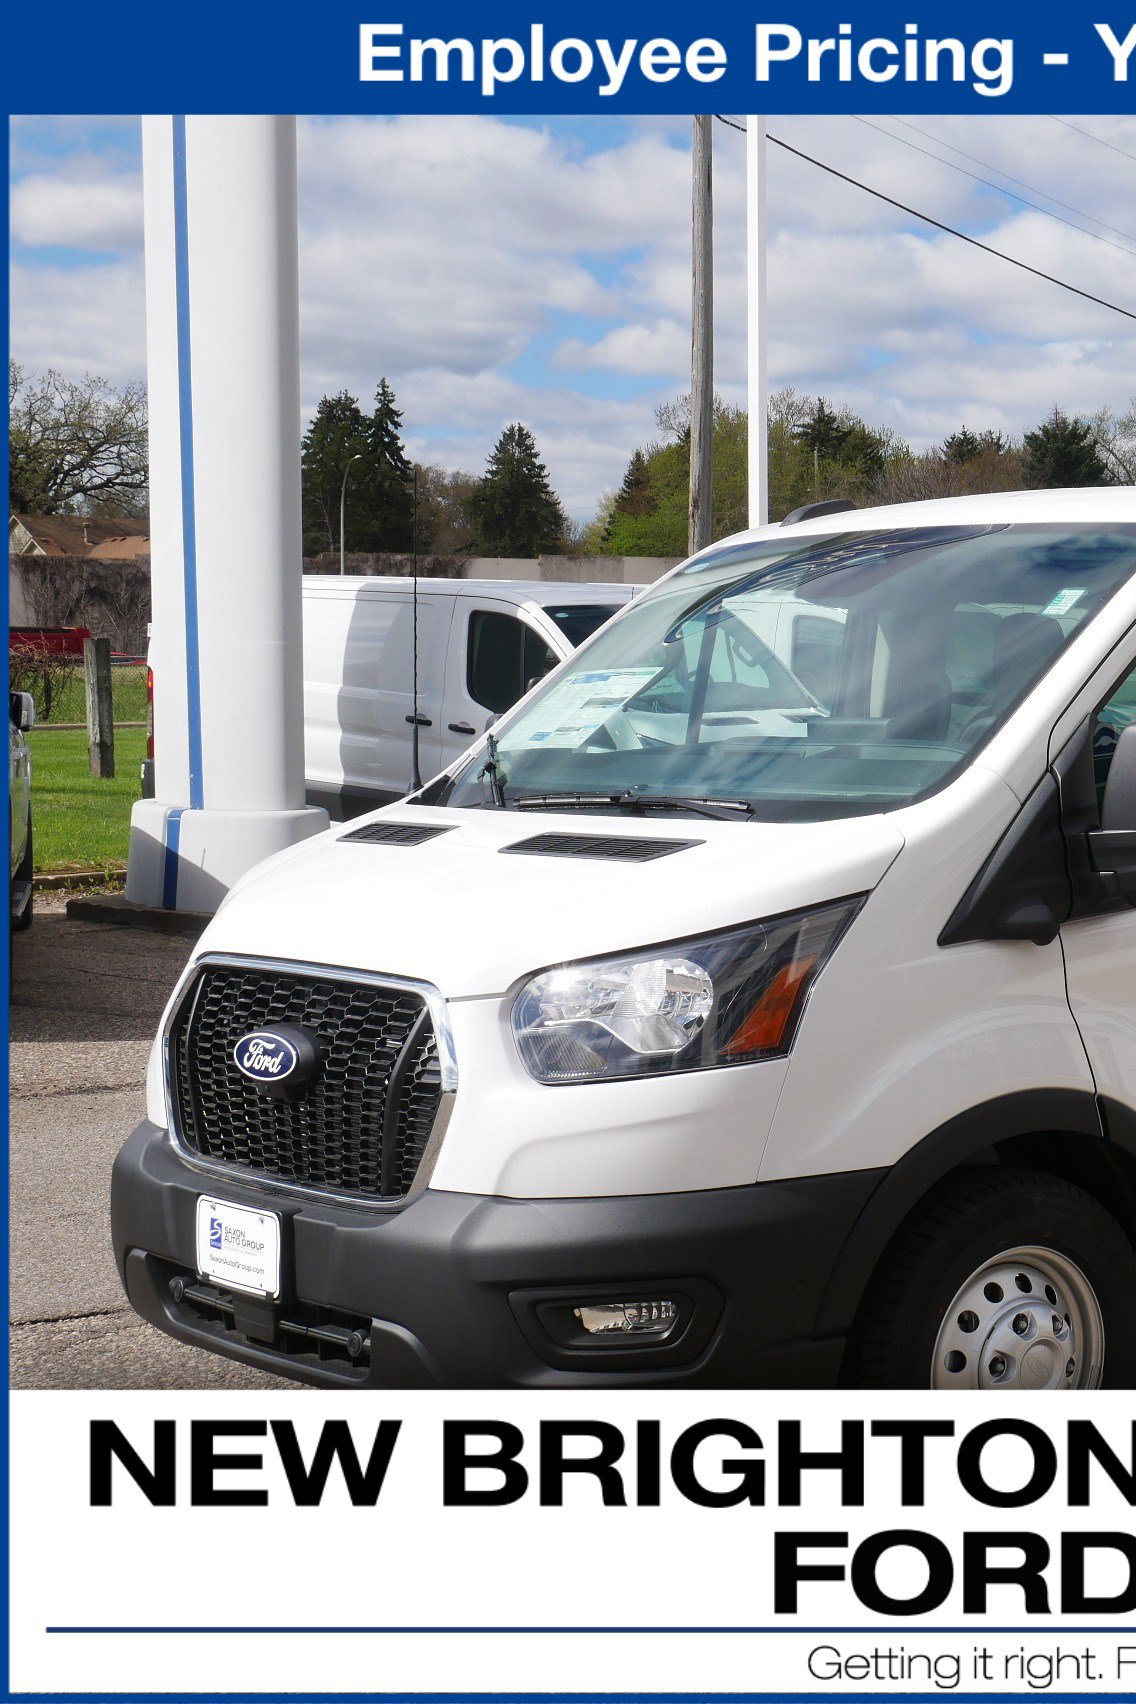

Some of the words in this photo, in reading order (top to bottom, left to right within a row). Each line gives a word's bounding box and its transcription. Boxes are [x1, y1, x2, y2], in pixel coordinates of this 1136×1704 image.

[243, 1038, 285, 1074] Ford
[224, 1226, 246, 1238] SAXON
[224, 1235, 241, 1246] AUTO
[241, 1238, 265, 1251] GROUP
[209, 1253, 265, 1275] SaxonAutoGroup.com
